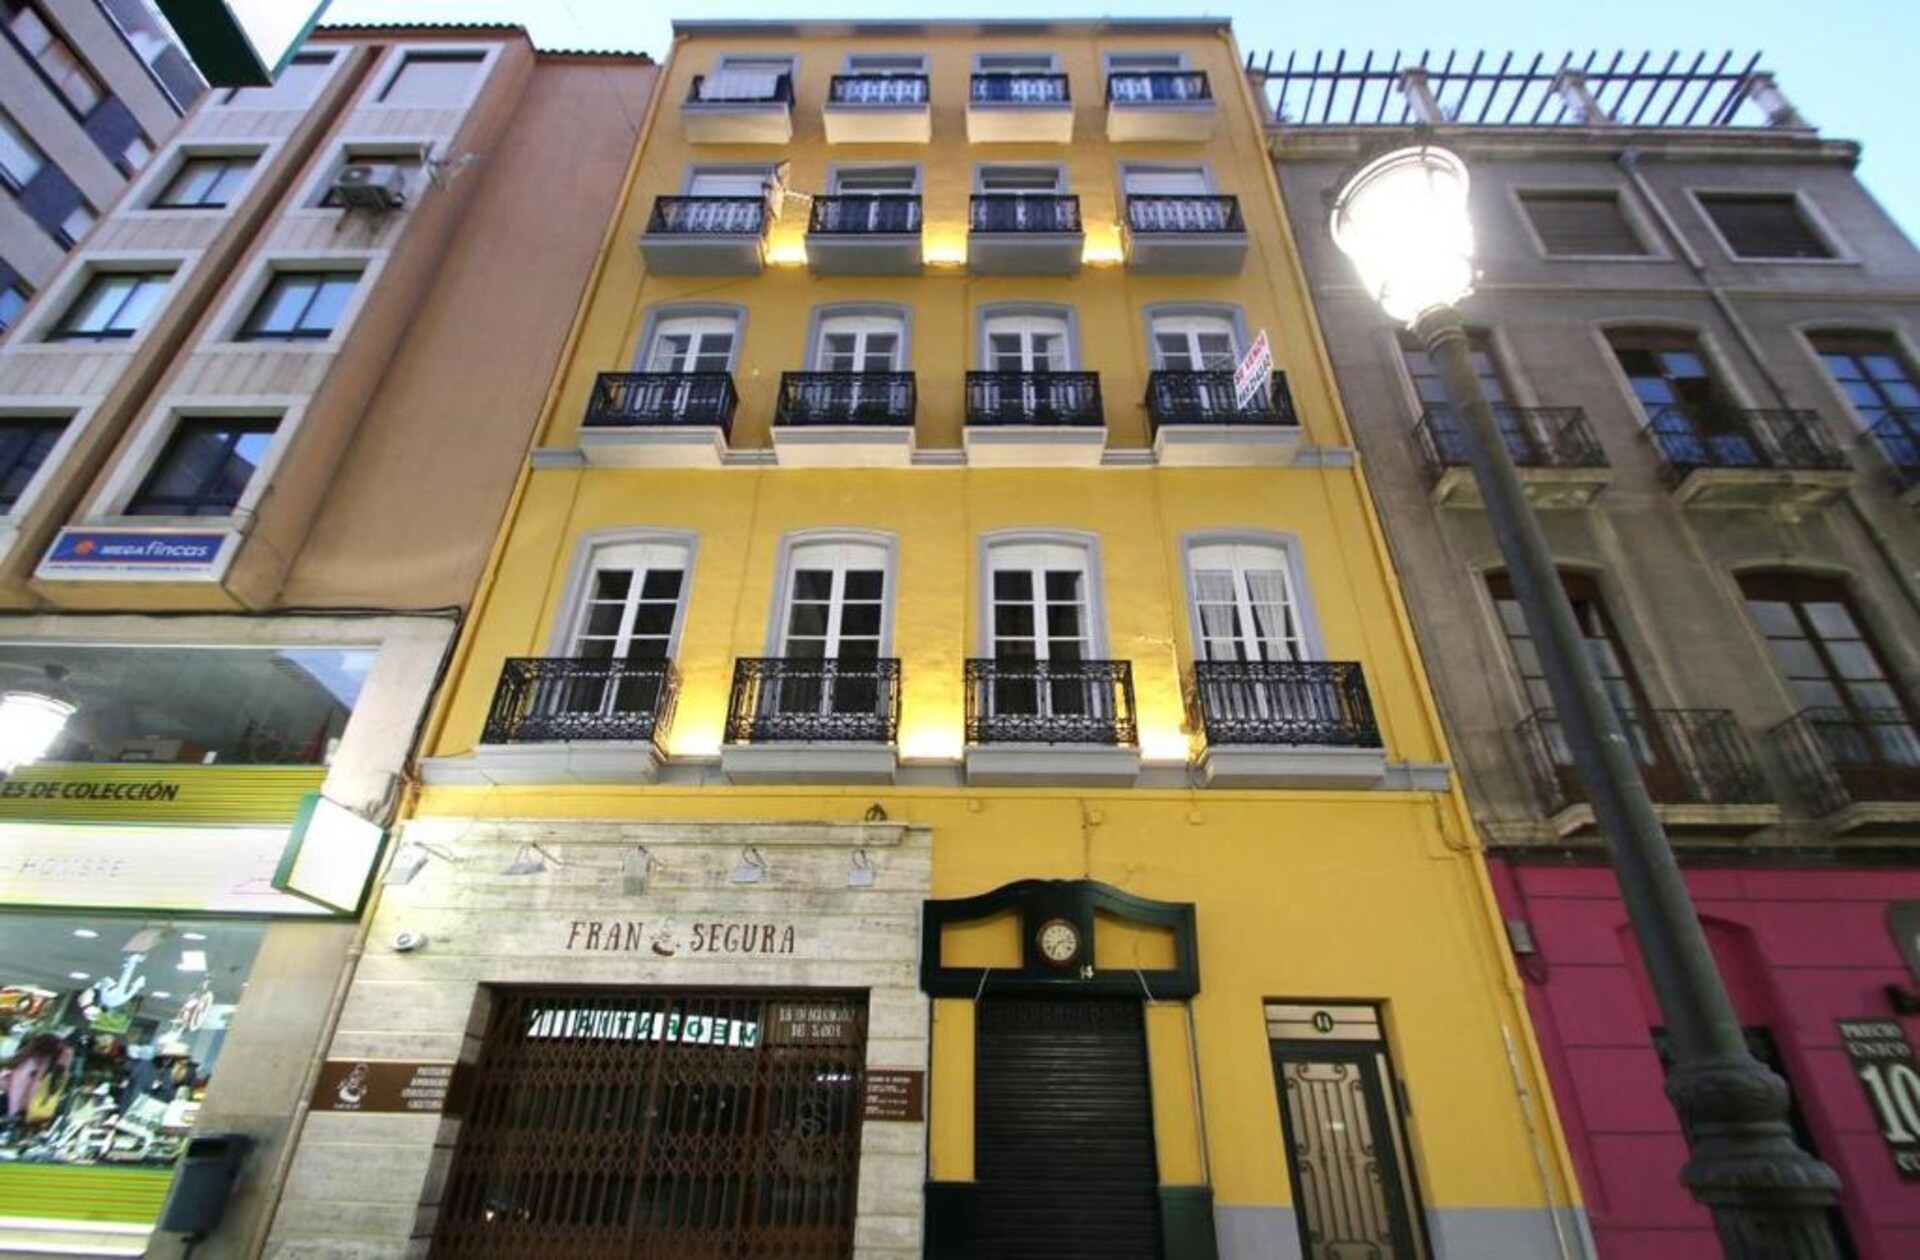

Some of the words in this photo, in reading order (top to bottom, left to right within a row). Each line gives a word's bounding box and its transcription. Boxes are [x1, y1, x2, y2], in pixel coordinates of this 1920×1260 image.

[31, 781, 61, 799] DE
[62, 779, 179, 801] COLECCIÓN
[566, 921, 644, 951] FRAN
[689, 922, 796, 954] SEGURA
[1840, 1023, 1903, 1038] PRECIO
